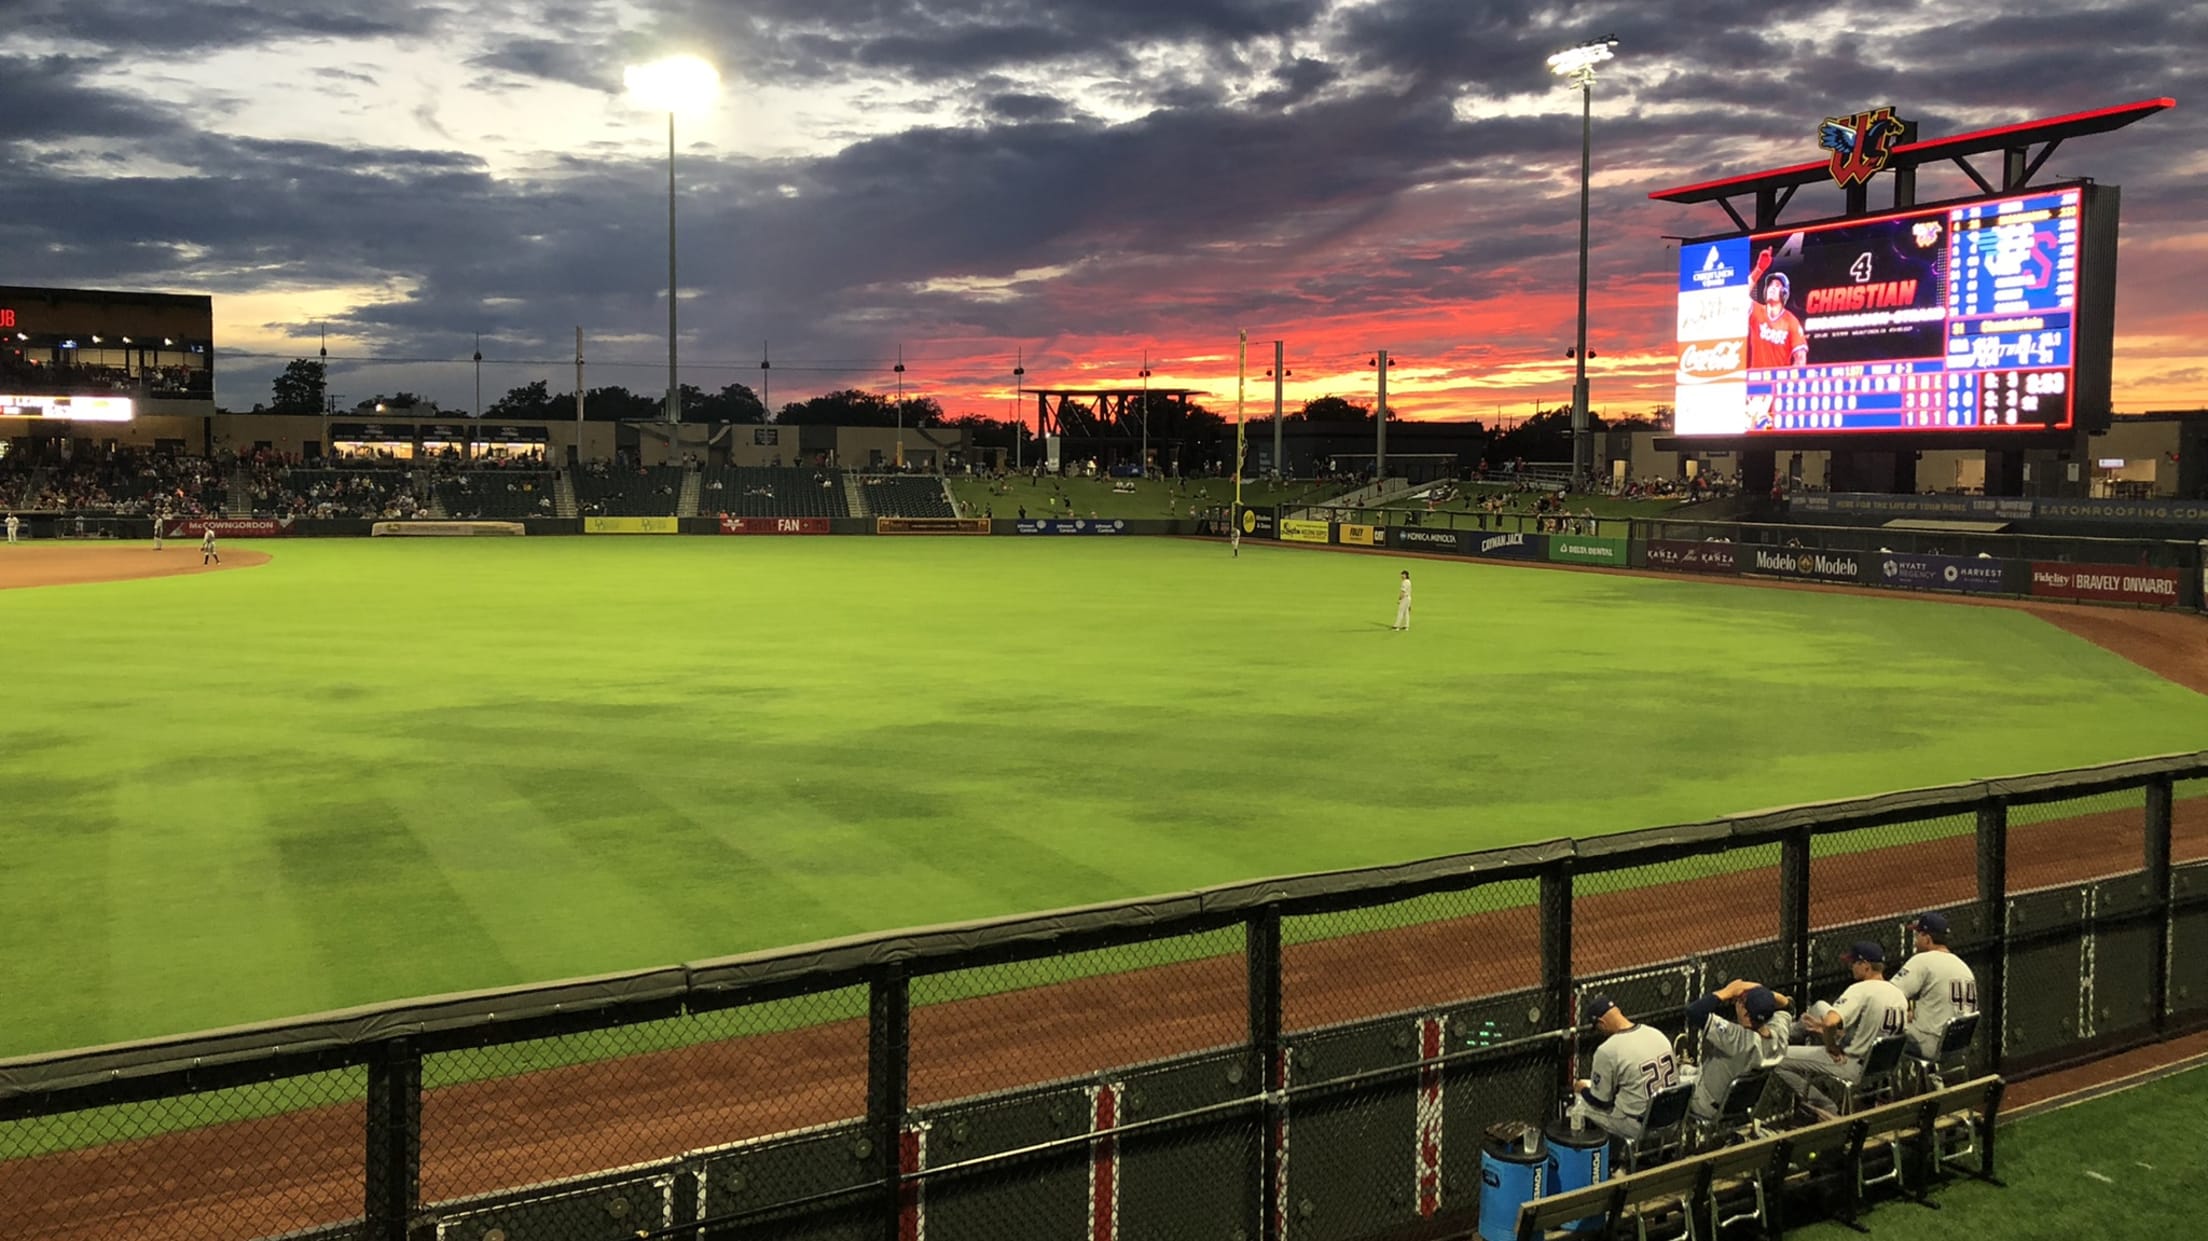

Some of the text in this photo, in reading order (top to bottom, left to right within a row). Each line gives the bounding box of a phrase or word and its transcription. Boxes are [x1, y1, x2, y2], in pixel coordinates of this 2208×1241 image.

[1850, 252, 1872, 283] 4
[1805, 279, 1917, 314] CHRISTIAN
[778, 519, 800, 531] FAN
[1407, 532, 1457, 543] KONICA MINOLTA
[1506, 532, 1524, 547] JACK
[1568, 545, 1613, 557] DELTA DENTAL
[1756, 551, 1857, 576] Modelo Modelo
[1899, 561, 1927, 571] HYATT
[1899, 570, 1936, 580] REGENCY
[1960, 567, 2002, 578] HARVEST
[2034, 571, 2070, 585] Fidelity
[2076, 574, 2121, 591] BRAVELY
[1950, 980, 1978, 1012] 44
[1882, 1007, 1906, 1036] 41
[1639, 1053, 1677, 1098] 22
